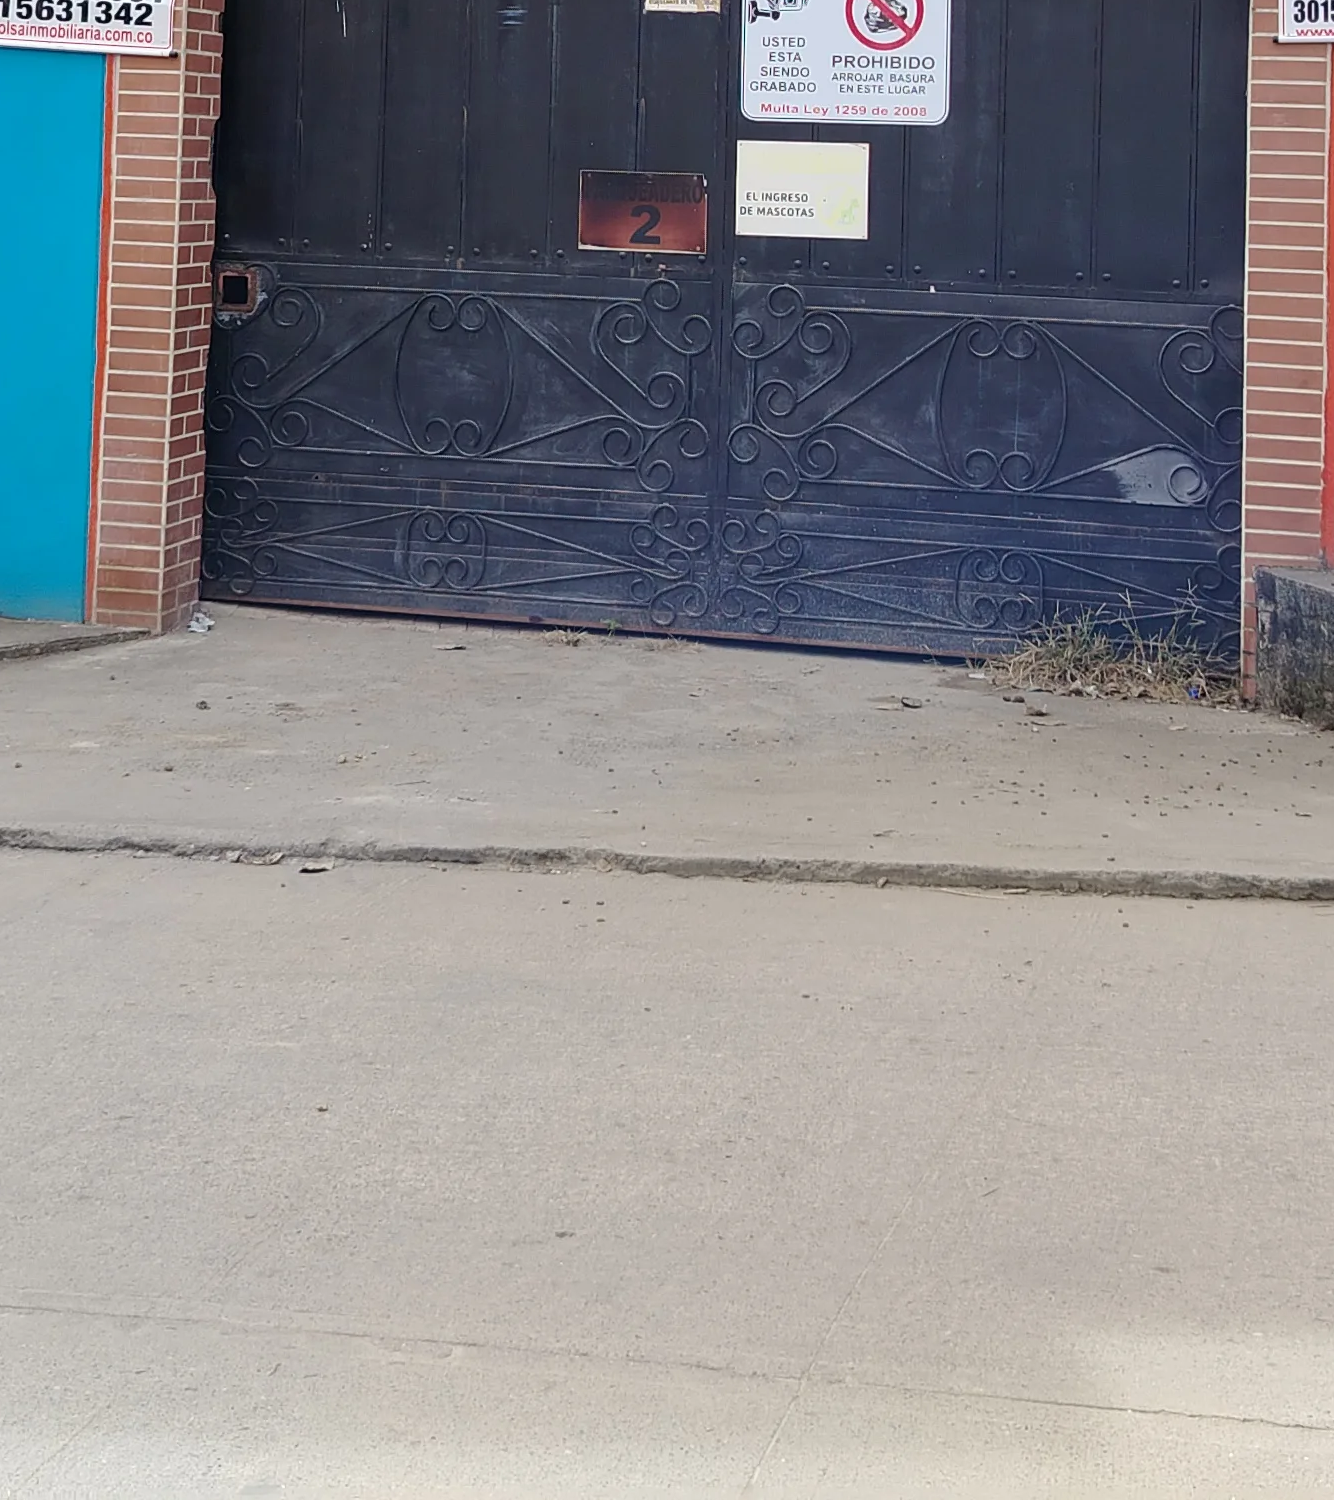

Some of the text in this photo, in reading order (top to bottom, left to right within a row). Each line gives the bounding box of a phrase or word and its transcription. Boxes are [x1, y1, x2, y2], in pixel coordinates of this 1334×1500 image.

[762, 36, 806, 48] USTED
[769, 51, 802, 63] ESTA
[832, 55, 935, 70] PROHIBIDO
[760, 66, 810, 78] SIENDO
[831, 73, 935, 83] ARROJAR BASURA
[749, 81, 817, 93] GRABADO
[839, 84, 926, 95] EN ESTE LUGAR
[760, 103, 927, 117] Multa Ley 1259 de 2008
[746, 191, 809, 203] EL INGRESO
[739, 206, 815, 218] DE MASCOTAS
[629, 204, 661, 244] 2
